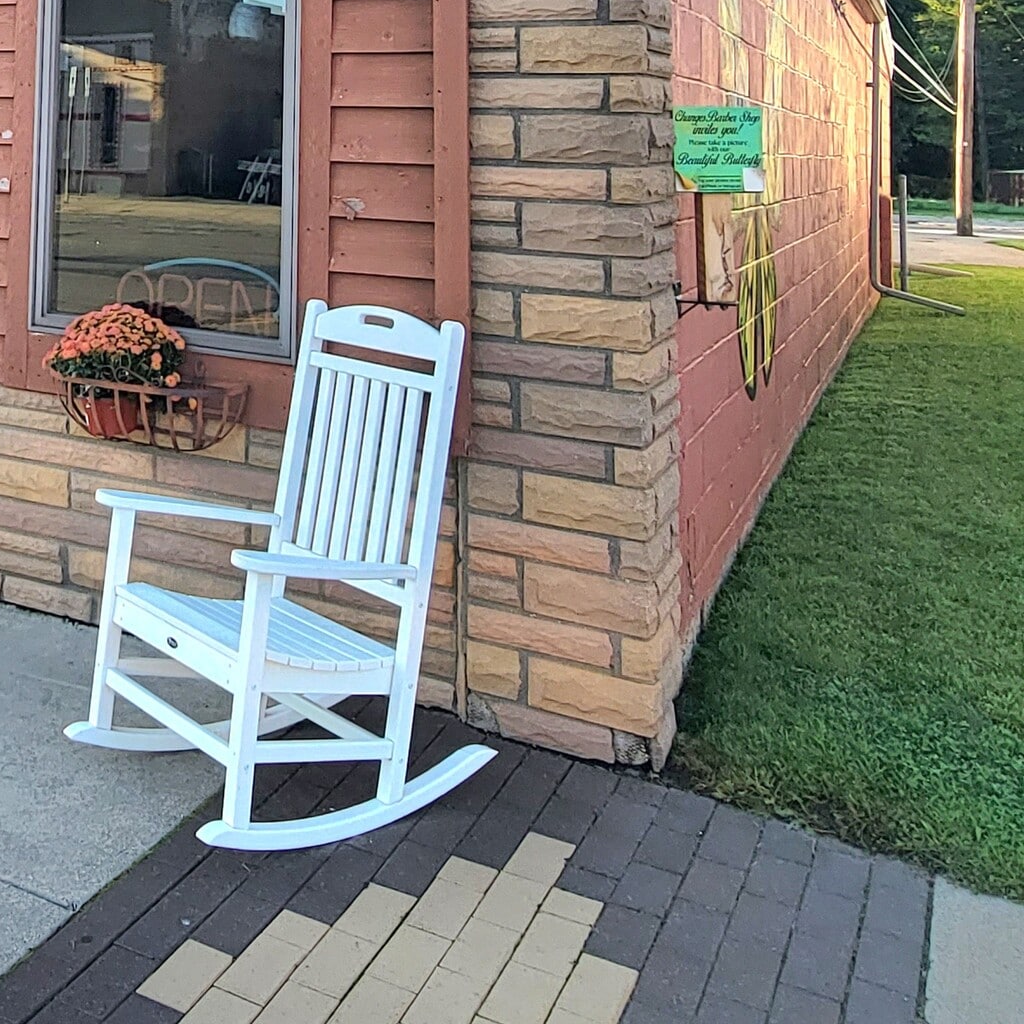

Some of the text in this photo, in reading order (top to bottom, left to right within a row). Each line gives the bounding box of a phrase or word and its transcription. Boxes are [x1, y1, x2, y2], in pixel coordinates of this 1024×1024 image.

[675, 110, 760, 126] Changes Barber Shop
[692, 123, 744, 138] invites you!
[676, 152, 762, 169] Beautiful Butterfly
